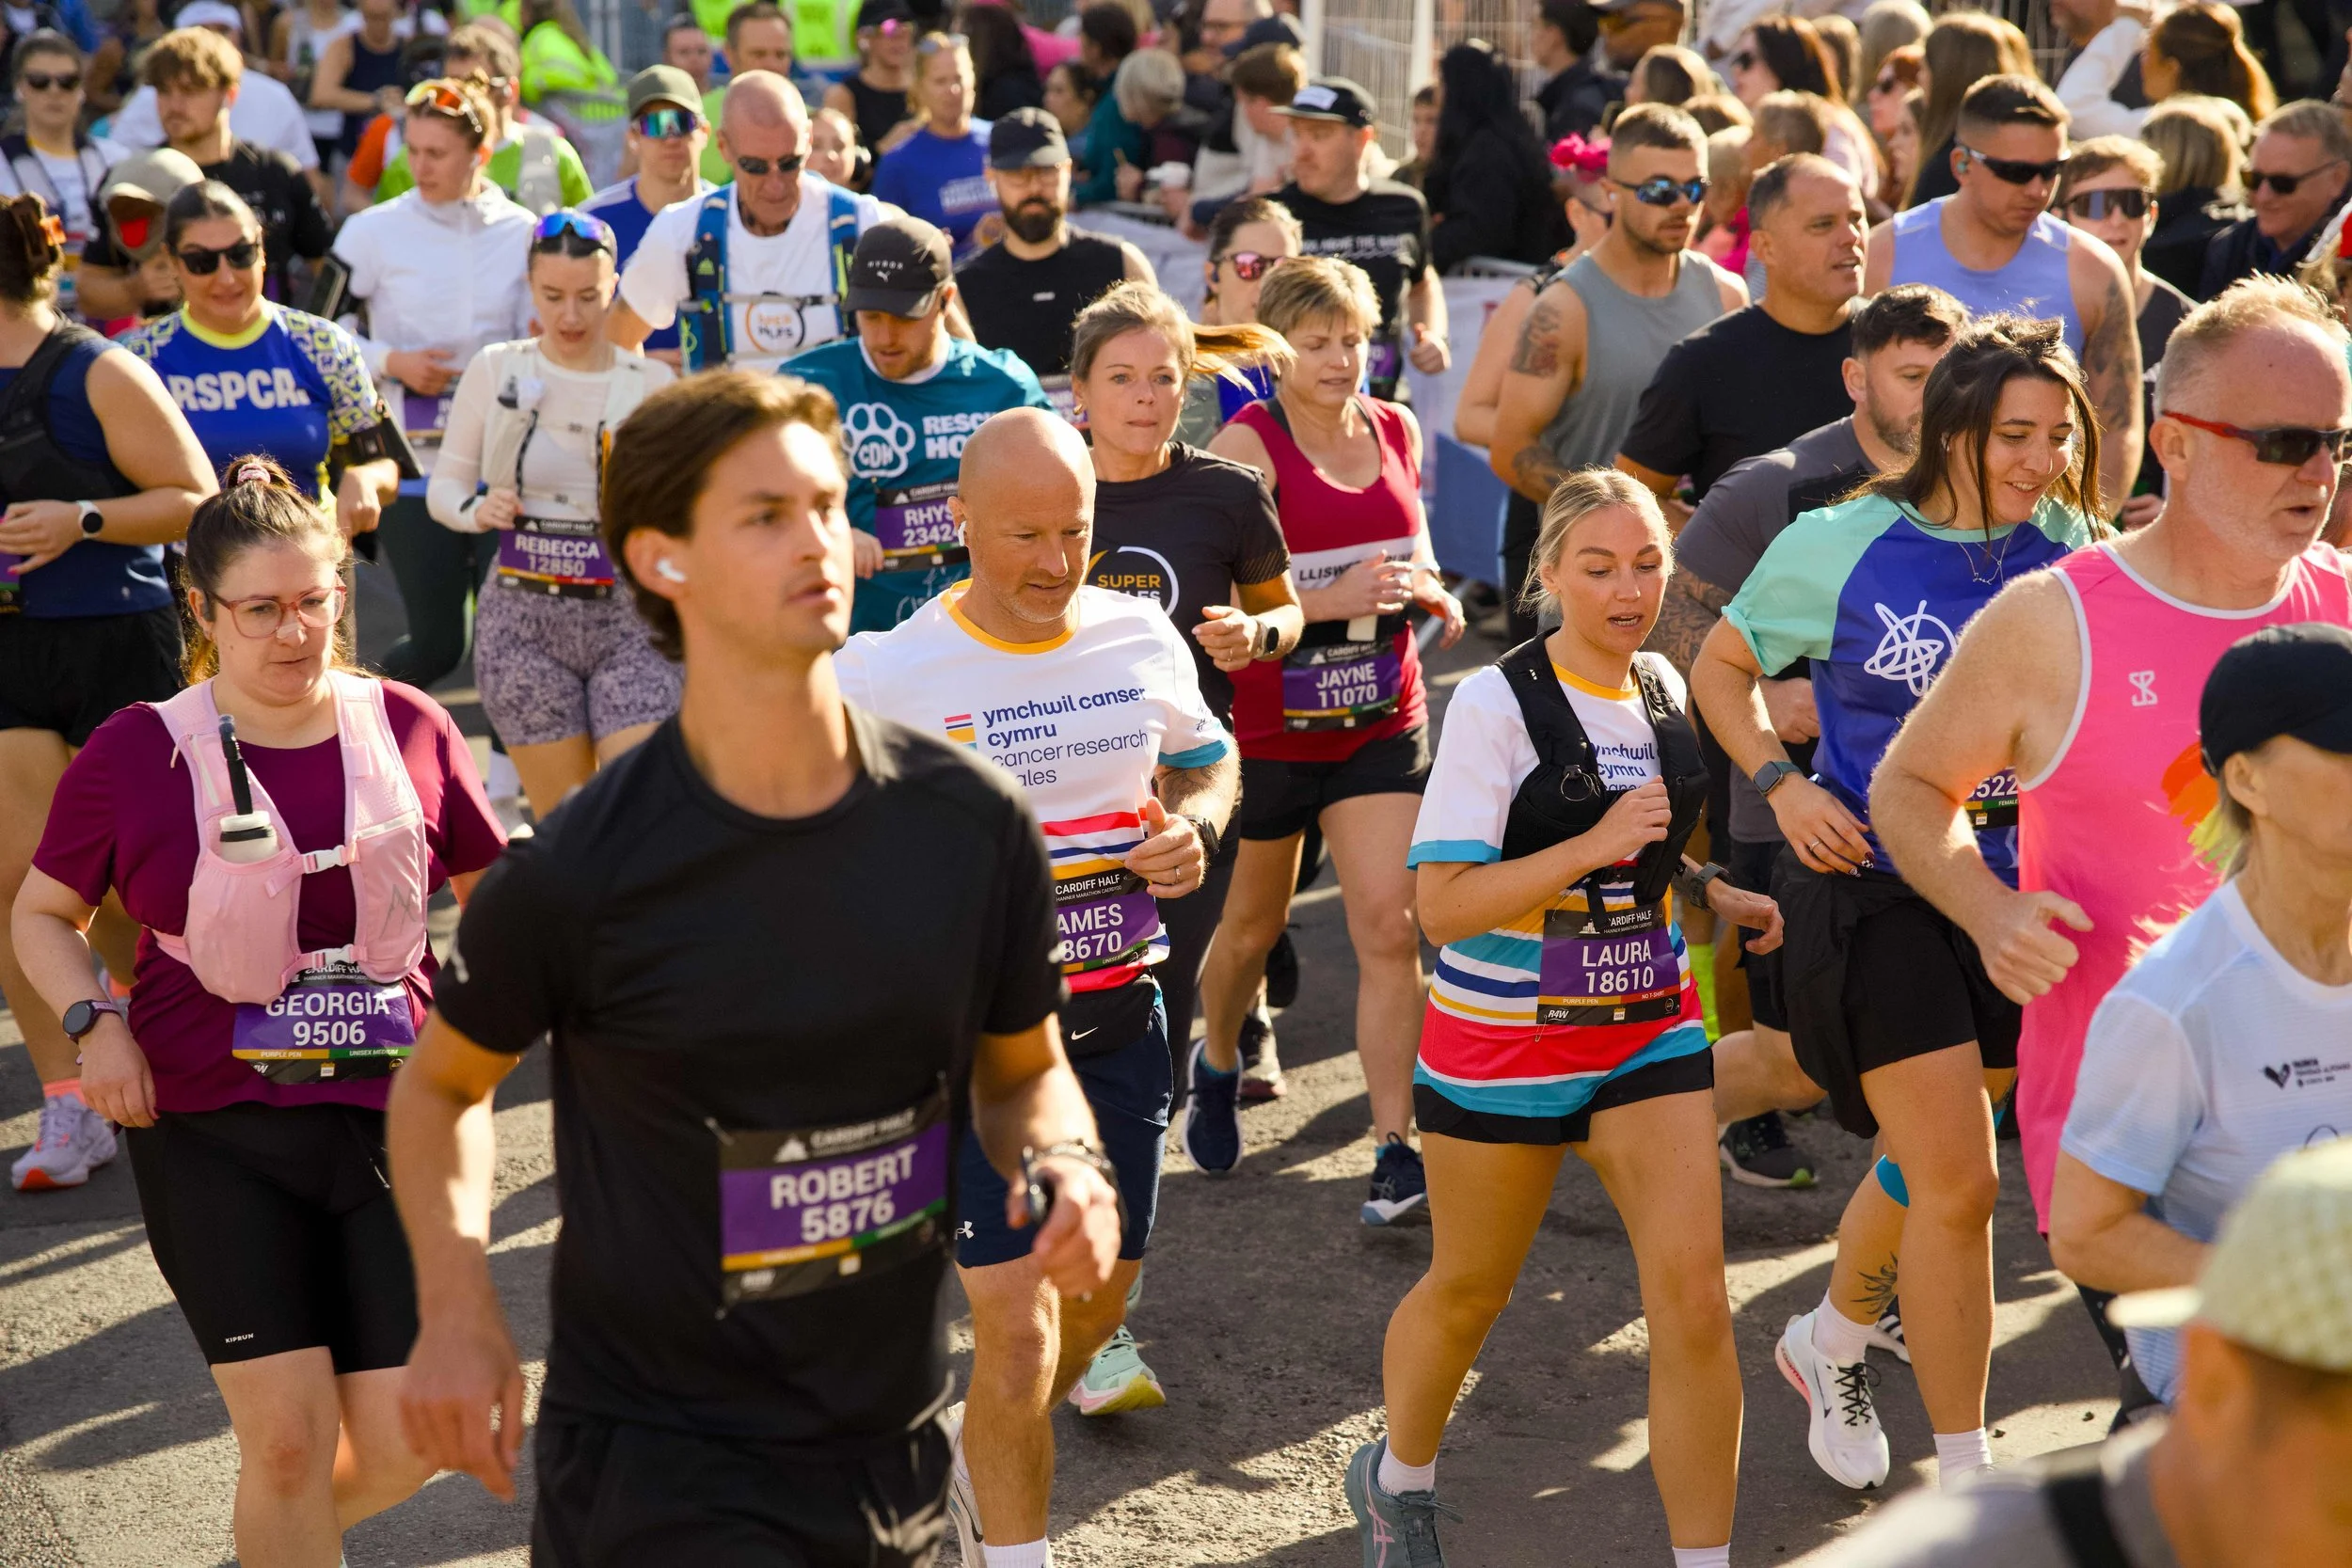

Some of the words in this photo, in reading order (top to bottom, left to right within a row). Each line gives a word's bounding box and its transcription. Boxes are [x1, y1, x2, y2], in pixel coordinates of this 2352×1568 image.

[922, 412, 993, 436] RESC
[858, 441, 894, 468] CDH
[925, 434, 968, 459] HO
[515, 533, 601, 559] REBECCA
[528, 554, 587, 578] 12850
[1097, 574, 1161, 589] SUPER
[1314, 662, 1378, 689] JAYNE
[982, 695, 1077, 728] ymchwil
[1078, 687, 1147, 710] canser
[1317, 683, 1379, 708] 11070
[987, 723, 1057, 749] cymru
[993, 744, 1064, 768] cancer
[1067, 729, 1149, 758] research
[1017, 768, 1057, 787] ales
[1597, 763, 1647, 779] cymru
[1967, 774, 2018, 799] 522
[1055, 879, 1097, 895] CARDIFF
[1098, 874, 1120, 888] HALF
[1056, 895, 1076, 903] HANNER
[1076, 889, 1102, 900] MARATHON
[1057, 903, 1123, 935] AMES
[1609, 912, 1636, 927] ARDIFF
[1636, 910, 1653, 922] HALF
[1061, 930, 1122, 962] 8670
[1581, 939, 1652, 968] LAURA
[347, 964, 362, 974] HA
[1585, 966, 1655, 994] 18610
[265, 991, 390, 1017] GEORGIA
[1548, 1009, 1569, 1020] R4W
[293, 1021, 366, 1046] 9506
[770, 1143, 919, 1210] ROBERT
[800, 1190, 897, 1243] 5876
[225, 1333, 255, 1343] KIPRUN
